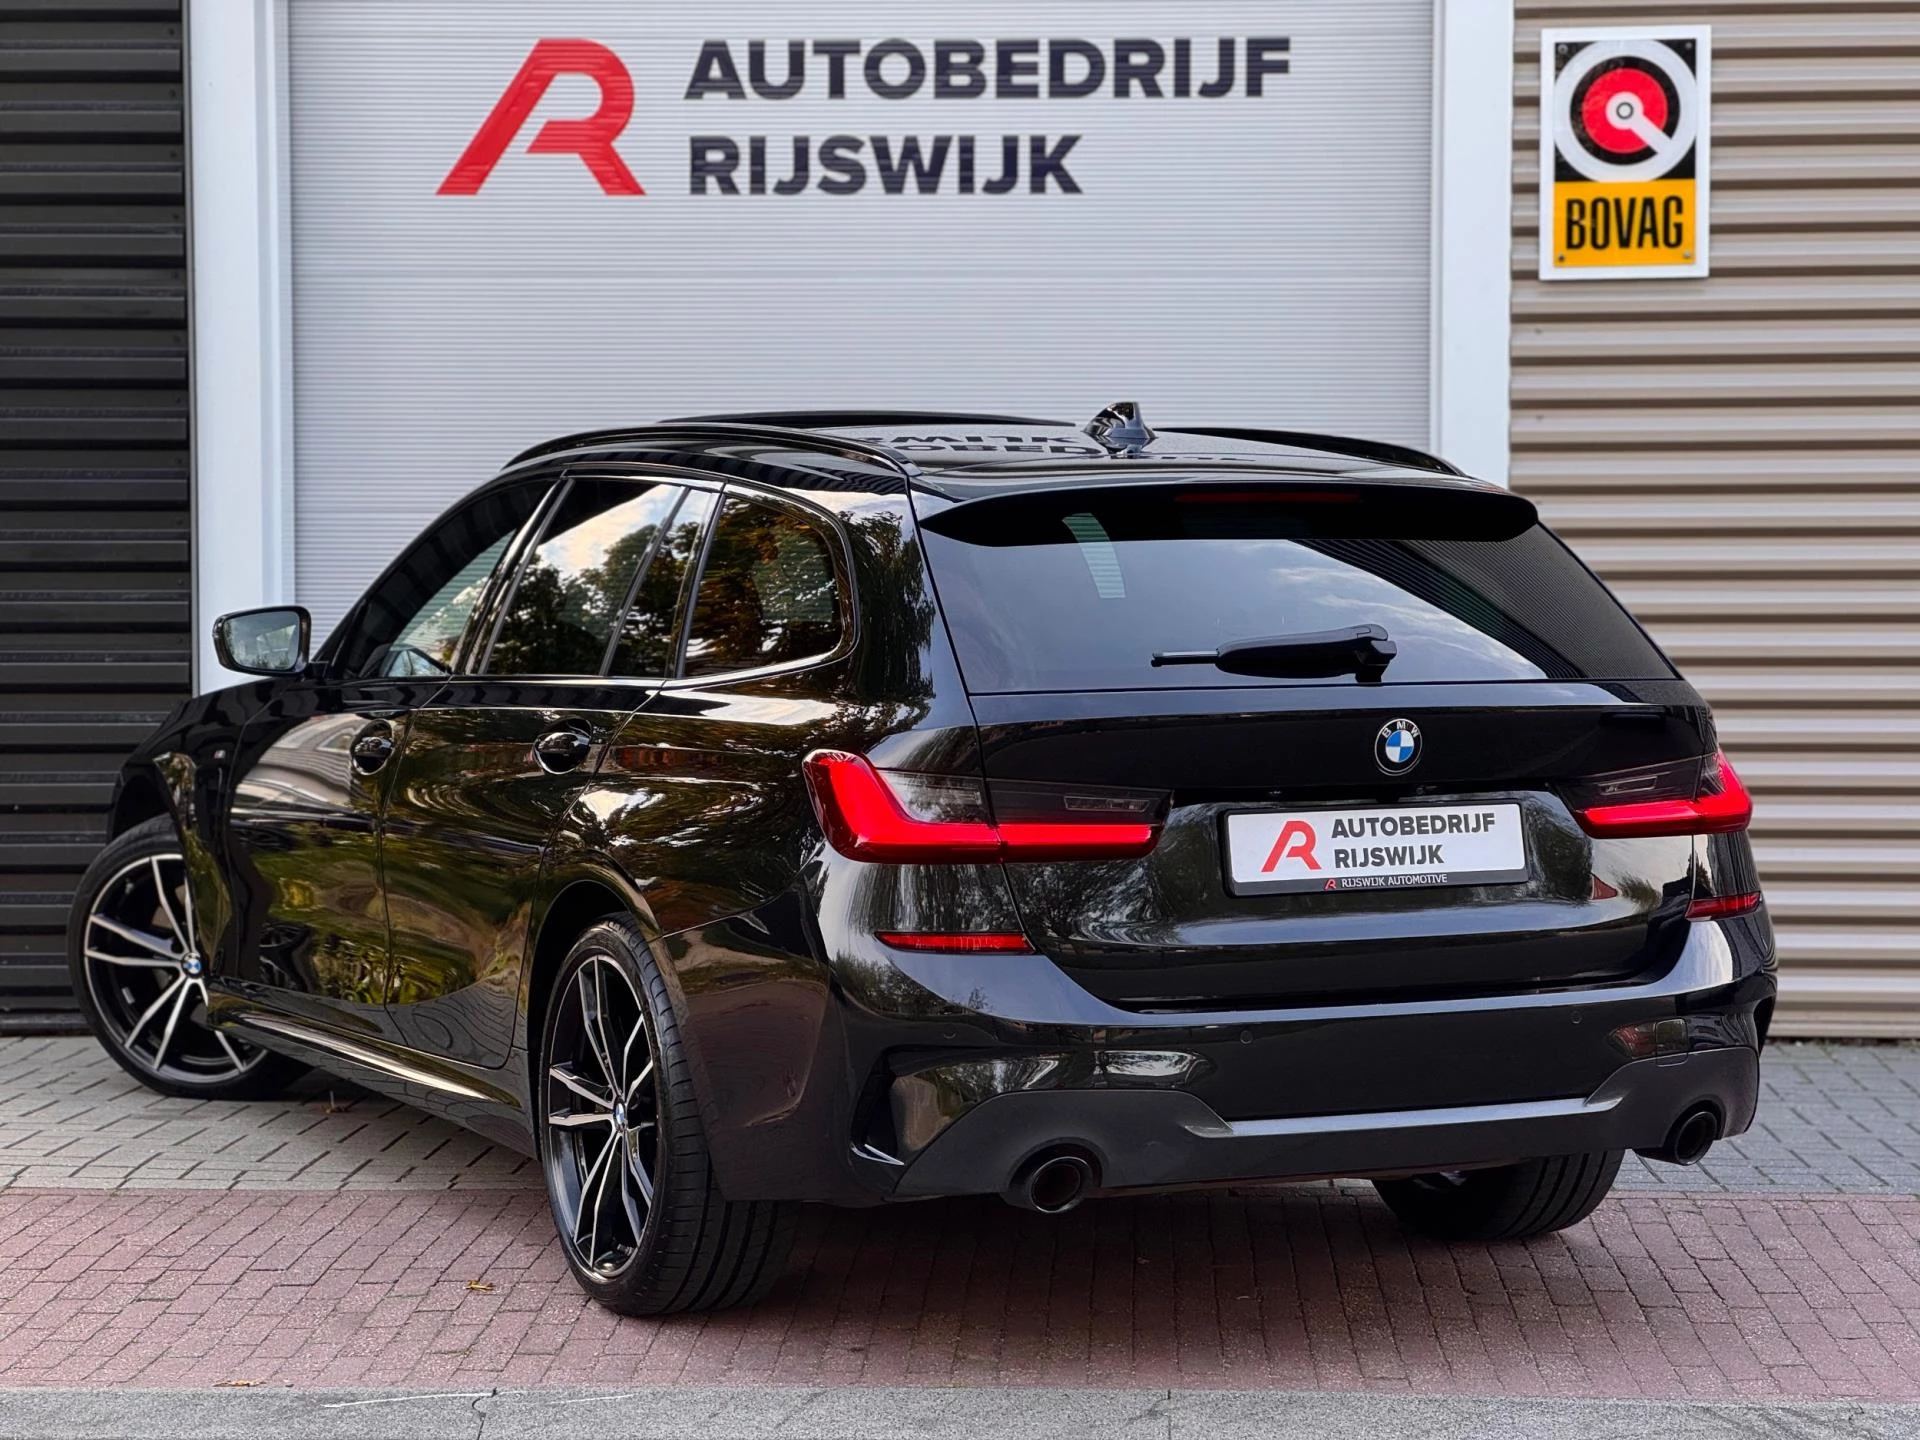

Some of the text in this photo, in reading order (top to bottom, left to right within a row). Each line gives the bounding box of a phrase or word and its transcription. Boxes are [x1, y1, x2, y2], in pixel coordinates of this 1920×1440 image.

[685, 37, 1291, 100] AUTOBEDRIJF
[689, 134, 1083, 196] RIJSWIJK
[1566, 195, 1683, 250] BOVAG
[1381, 720, 1420, 738] BMW
[1331, 812, 1495, 839] AUTOBEDRIJF
[1334, 844, 1444, 869] RIJSWIJK
[1341, 873, 1448, 888] RIJSWIJK AUTOMOTIVE
